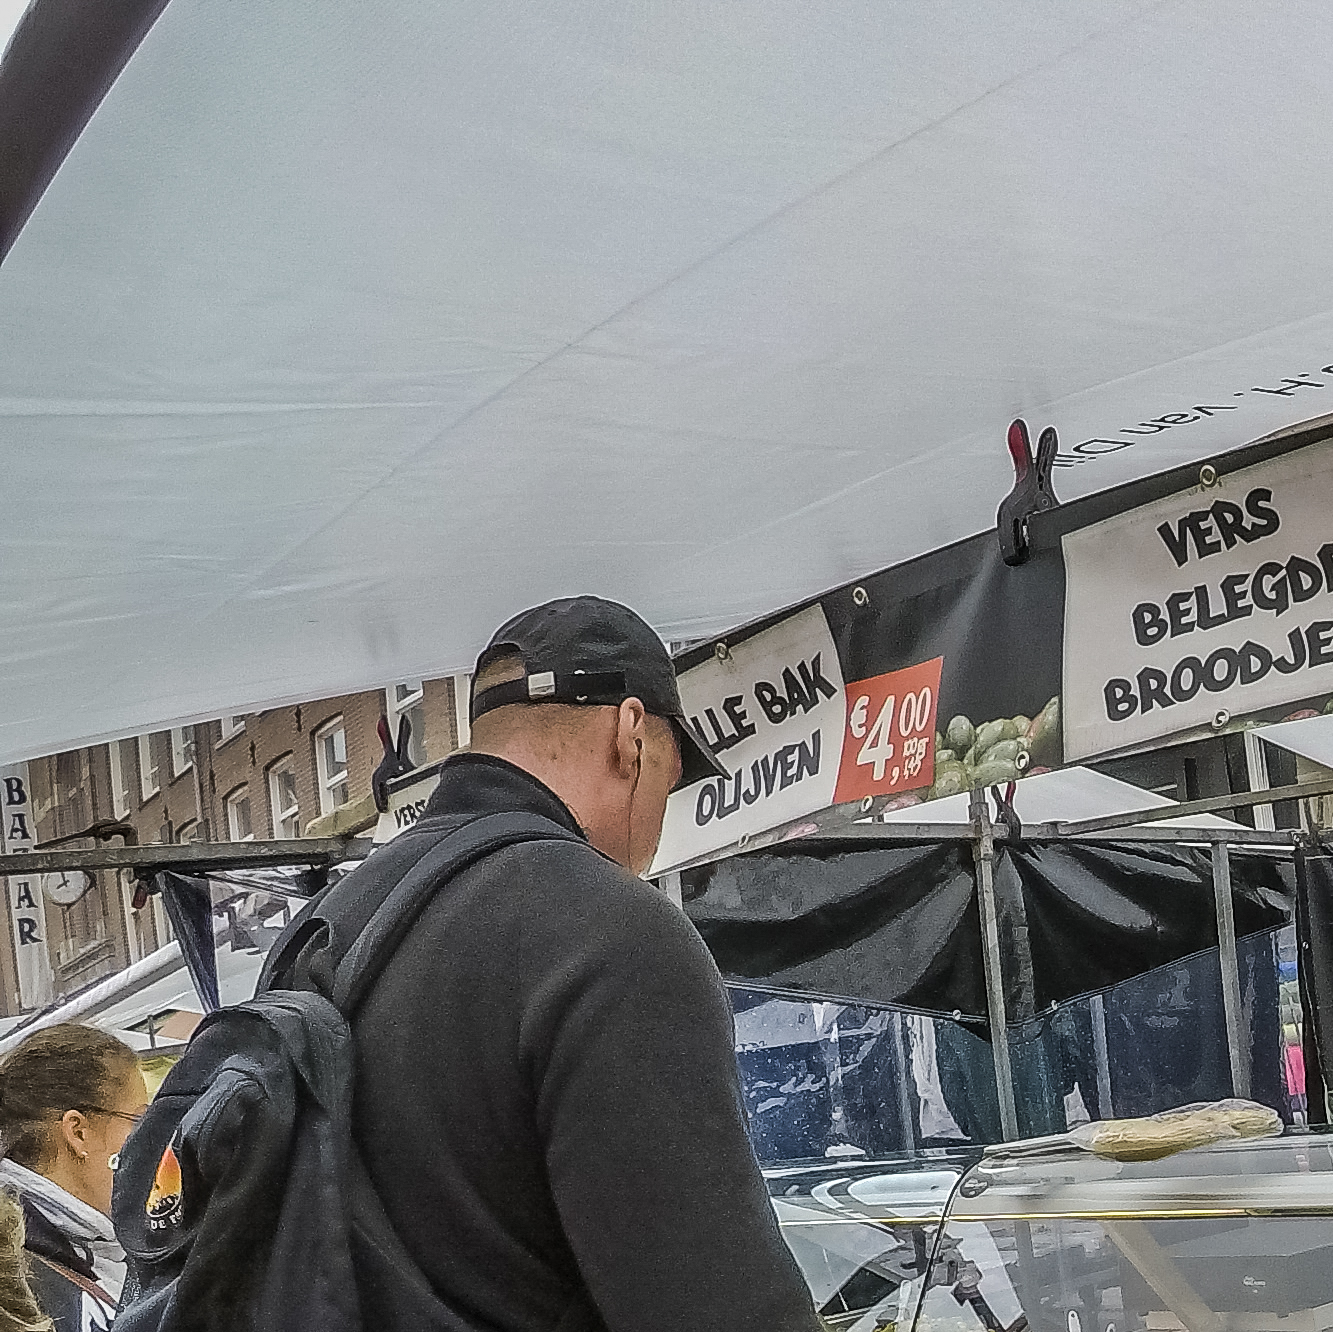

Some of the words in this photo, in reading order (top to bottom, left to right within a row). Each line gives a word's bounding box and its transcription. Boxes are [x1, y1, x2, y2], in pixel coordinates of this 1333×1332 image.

[1052, 438, 1136, 468] Dij
[1119, 405, 1239, 435] van
[1157, 487, 1281, 568] VERS
[754, 651, 838, 724] BAK
[695, 729, 821, 827] OLIJVEN
[3, 776, 43, 946] BAAR
